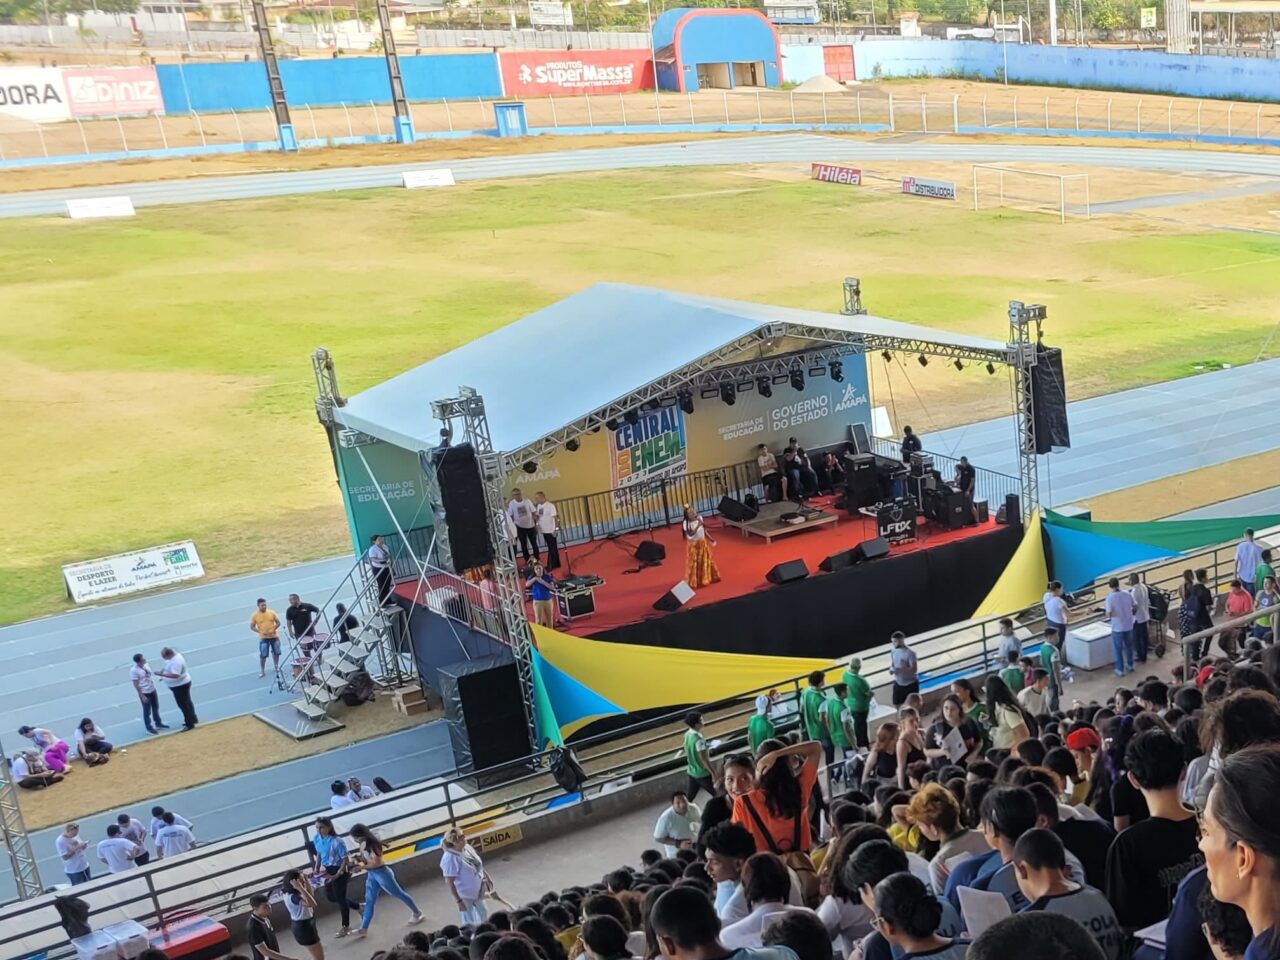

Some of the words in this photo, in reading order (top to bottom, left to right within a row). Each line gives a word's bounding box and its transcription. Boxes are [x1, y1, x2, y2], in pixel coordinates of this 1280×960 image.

[97, 80, 158, 102] DINIZ
[819, 166, 859, 185] Hiléia
[915, 183, 955, 198] DISTRIBUIDORA
[772, 395, 828, 420] GOVERNO
[834, 394, 867, 413] AMAPÁ
[718, 419, 754, 434] SECRETARIA
[754, 416, 763, 426] DE
[773, 419, 788, 431] DO
[791, 407, 829, 426] ESTADO
[723, 424, 764, 441] EDUCAÇÃO
[631, 431, 681, 473] ENEM
[402, 480, 414, 489] DE
[77, 569, 115, 582] DESPORTO
[94, 576, 117, 586] LAZER
[483, 832, 511, 846] SAÍDA
